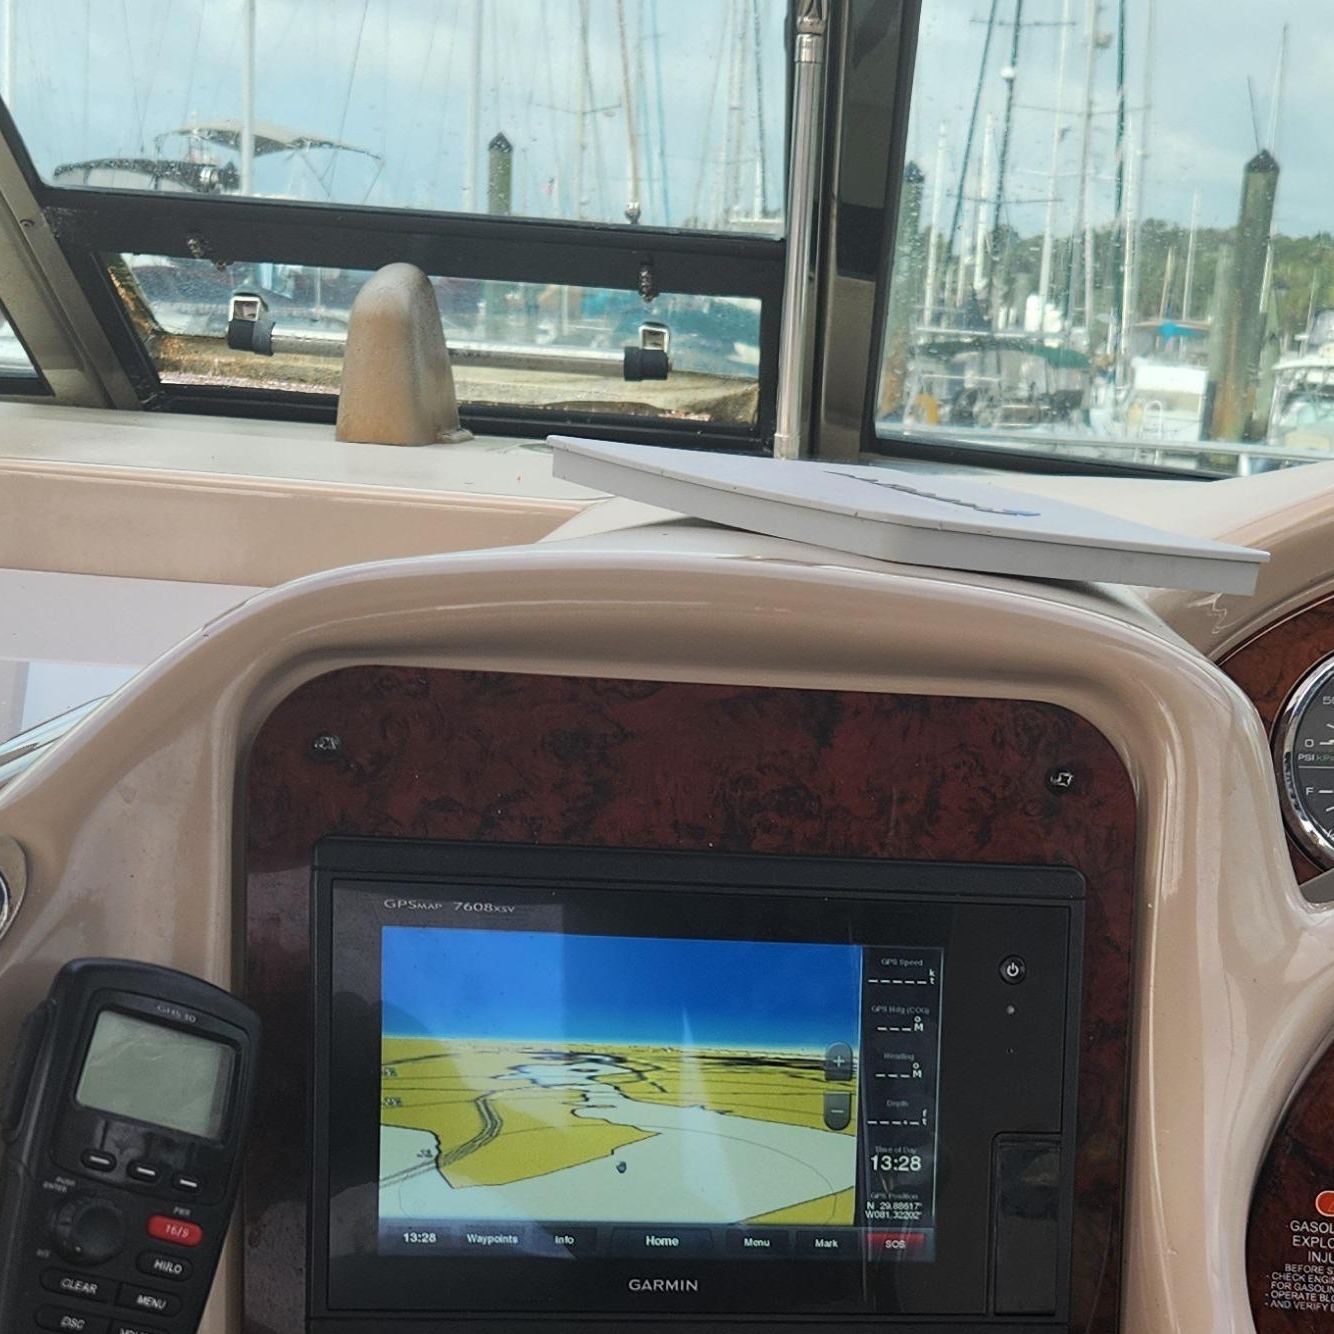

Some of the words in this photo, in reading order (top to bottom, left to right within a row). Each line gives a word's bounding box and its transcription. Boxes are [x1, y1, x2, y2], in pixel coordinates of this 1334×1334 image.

[1304, 739, 1314, 748] 0
[1298, 753, 1315, 761] PSI
[1305, 787, 1314, 796] F
[870, 1154, 922, 1172] 13:28
[866, 1201, 875, 1210] N
[402, 1231, 437, 1244] 13:28
[467, 1232, 519, 1247] Waypoints
[555, 1233, 575, 1245] Info
[645, 1234, 680, 1247] Home
[743, 1236, 770, 1248] Menu
[814, 1236, 839, 1249] Mark
[884, 1239, 906, 1249] SOS
[1284, 1263, 1325, 1275] BEFORE
[1271, 1271, 1306, 1282] CHECK
[61, 1277, 98, 1295] CLEAR
[628, 1278, 699, 1293] GARMIN
[1270, 1281, 1292, 1290] FOR
[136, 1294, 167, 1310] MENU
[1270, 1290, 1316, 1302] OPERATE
[1270, 1299, 1292, 1309] AND
[1293, 1301, 1329, 1312] VERIFY
[60, 1315, 86, 1330] DSC
